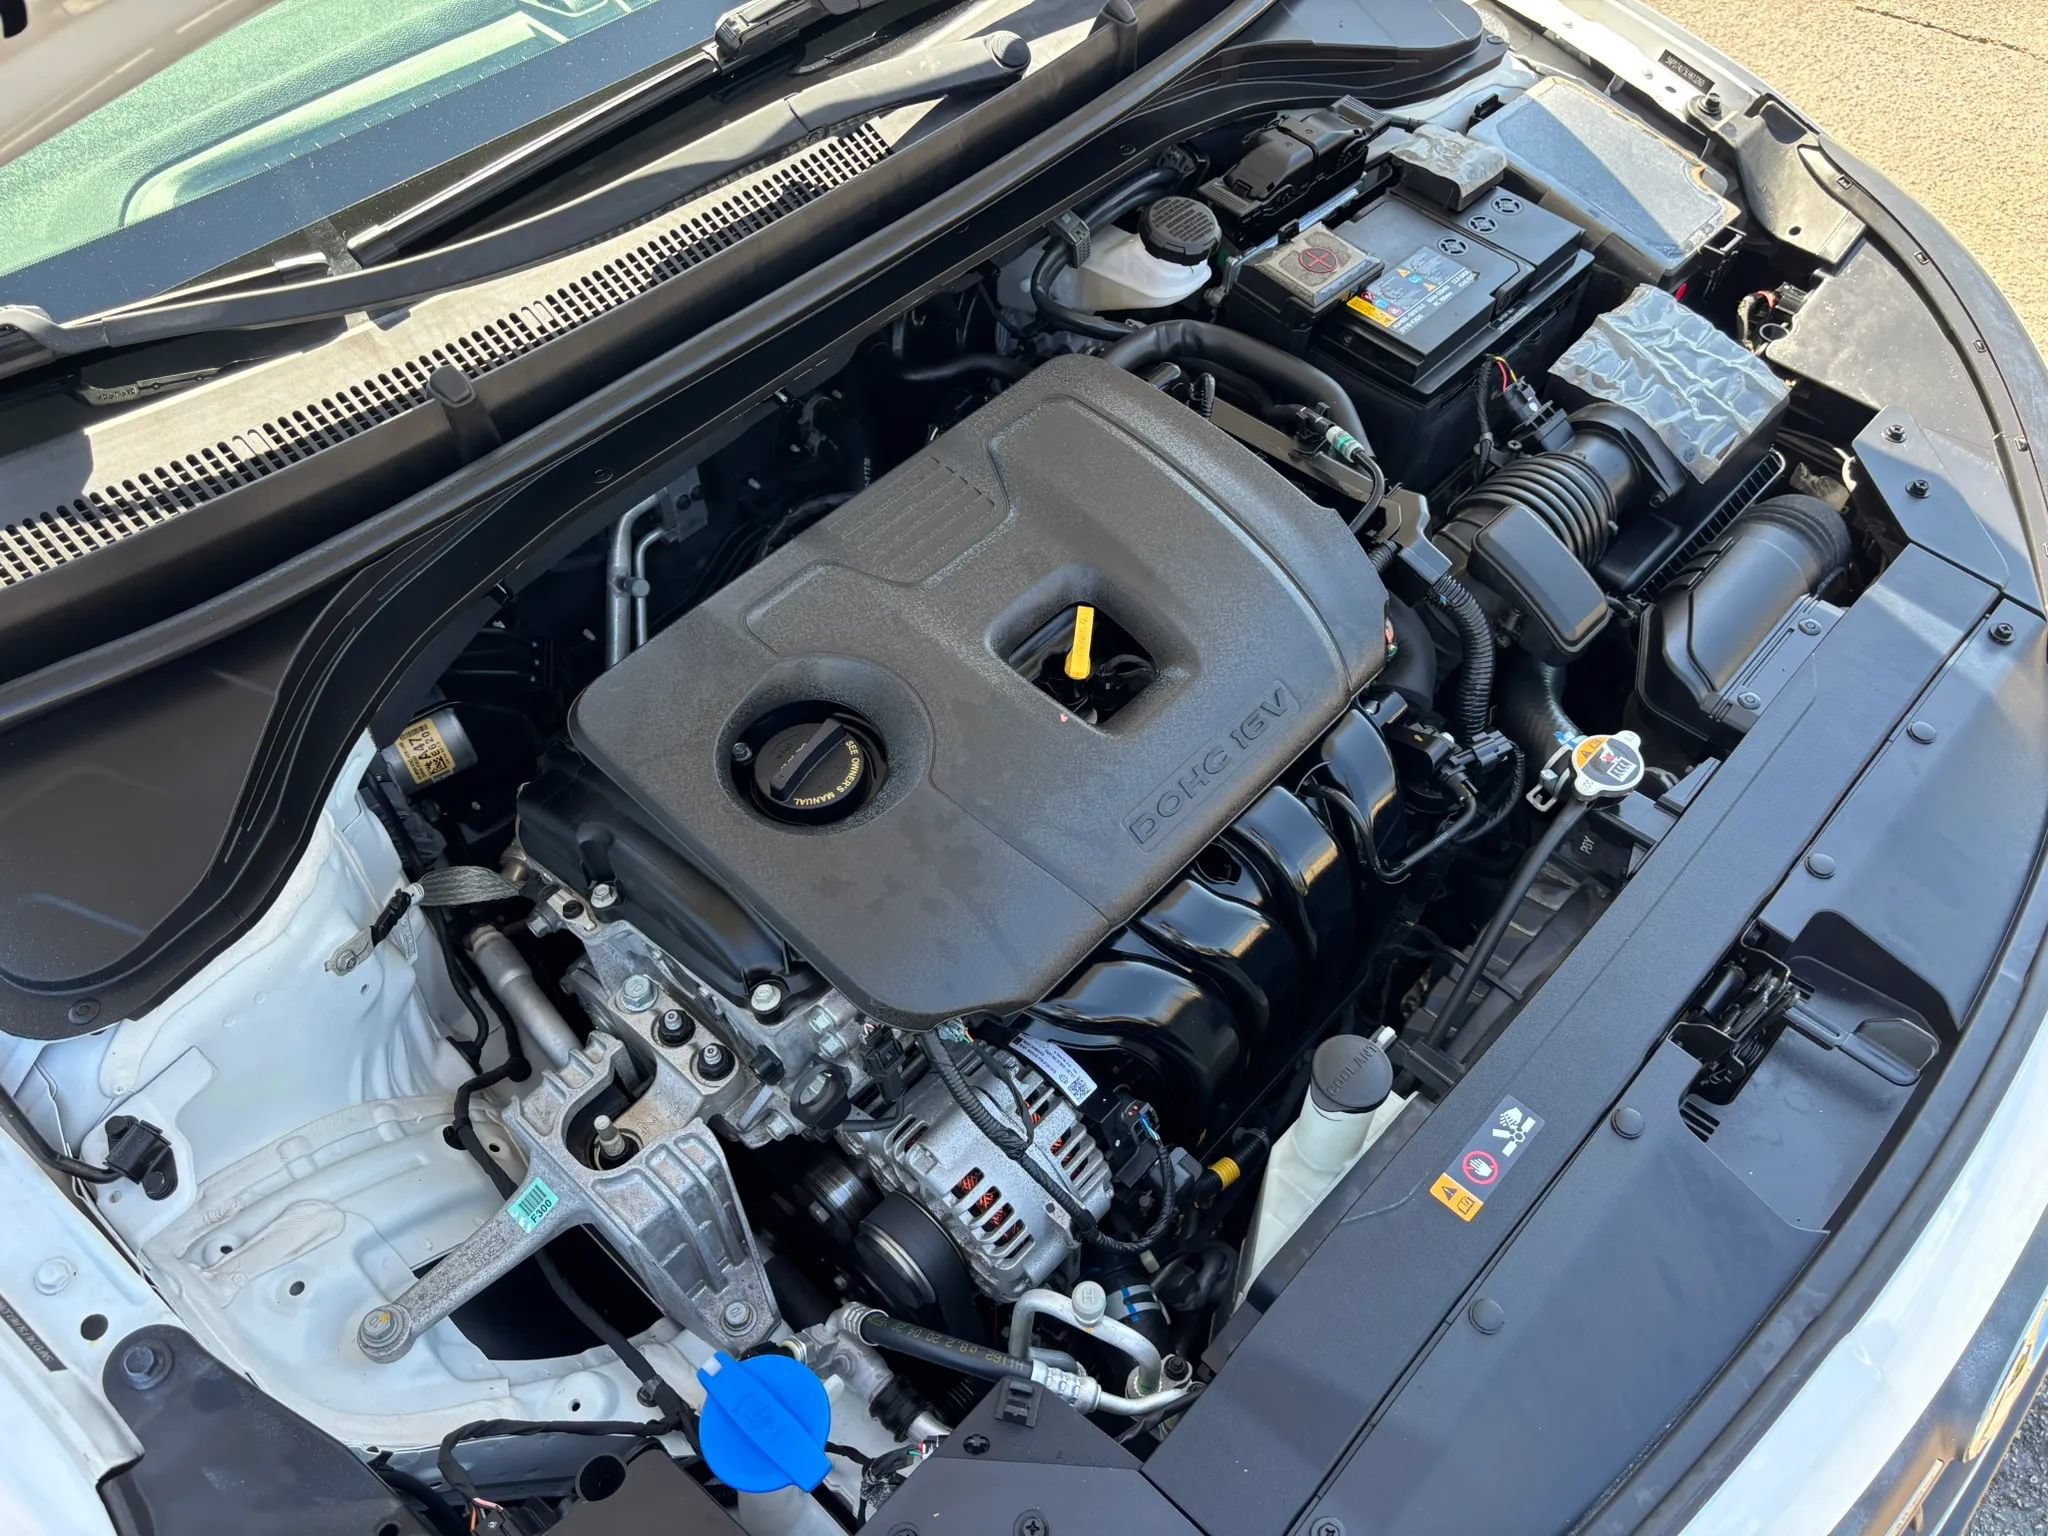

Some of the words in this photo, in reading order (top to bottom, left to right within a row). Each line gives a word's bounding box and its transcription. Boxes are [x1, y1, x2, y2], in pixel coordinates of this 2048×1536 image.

[408, 737, 431, 761] A47
[845, 740, 859, 756] SEE
[836, 757, 861, 793] OWNER'S
[1130, 745, 1230, 844] DOHC
[1230, 688, 1288, 750] 16V
[794, 791, 835, 806] MANUAL
[1326, 1042, 1378, 1097] COOLANT
[530, 1199, 553, 1224] F300
